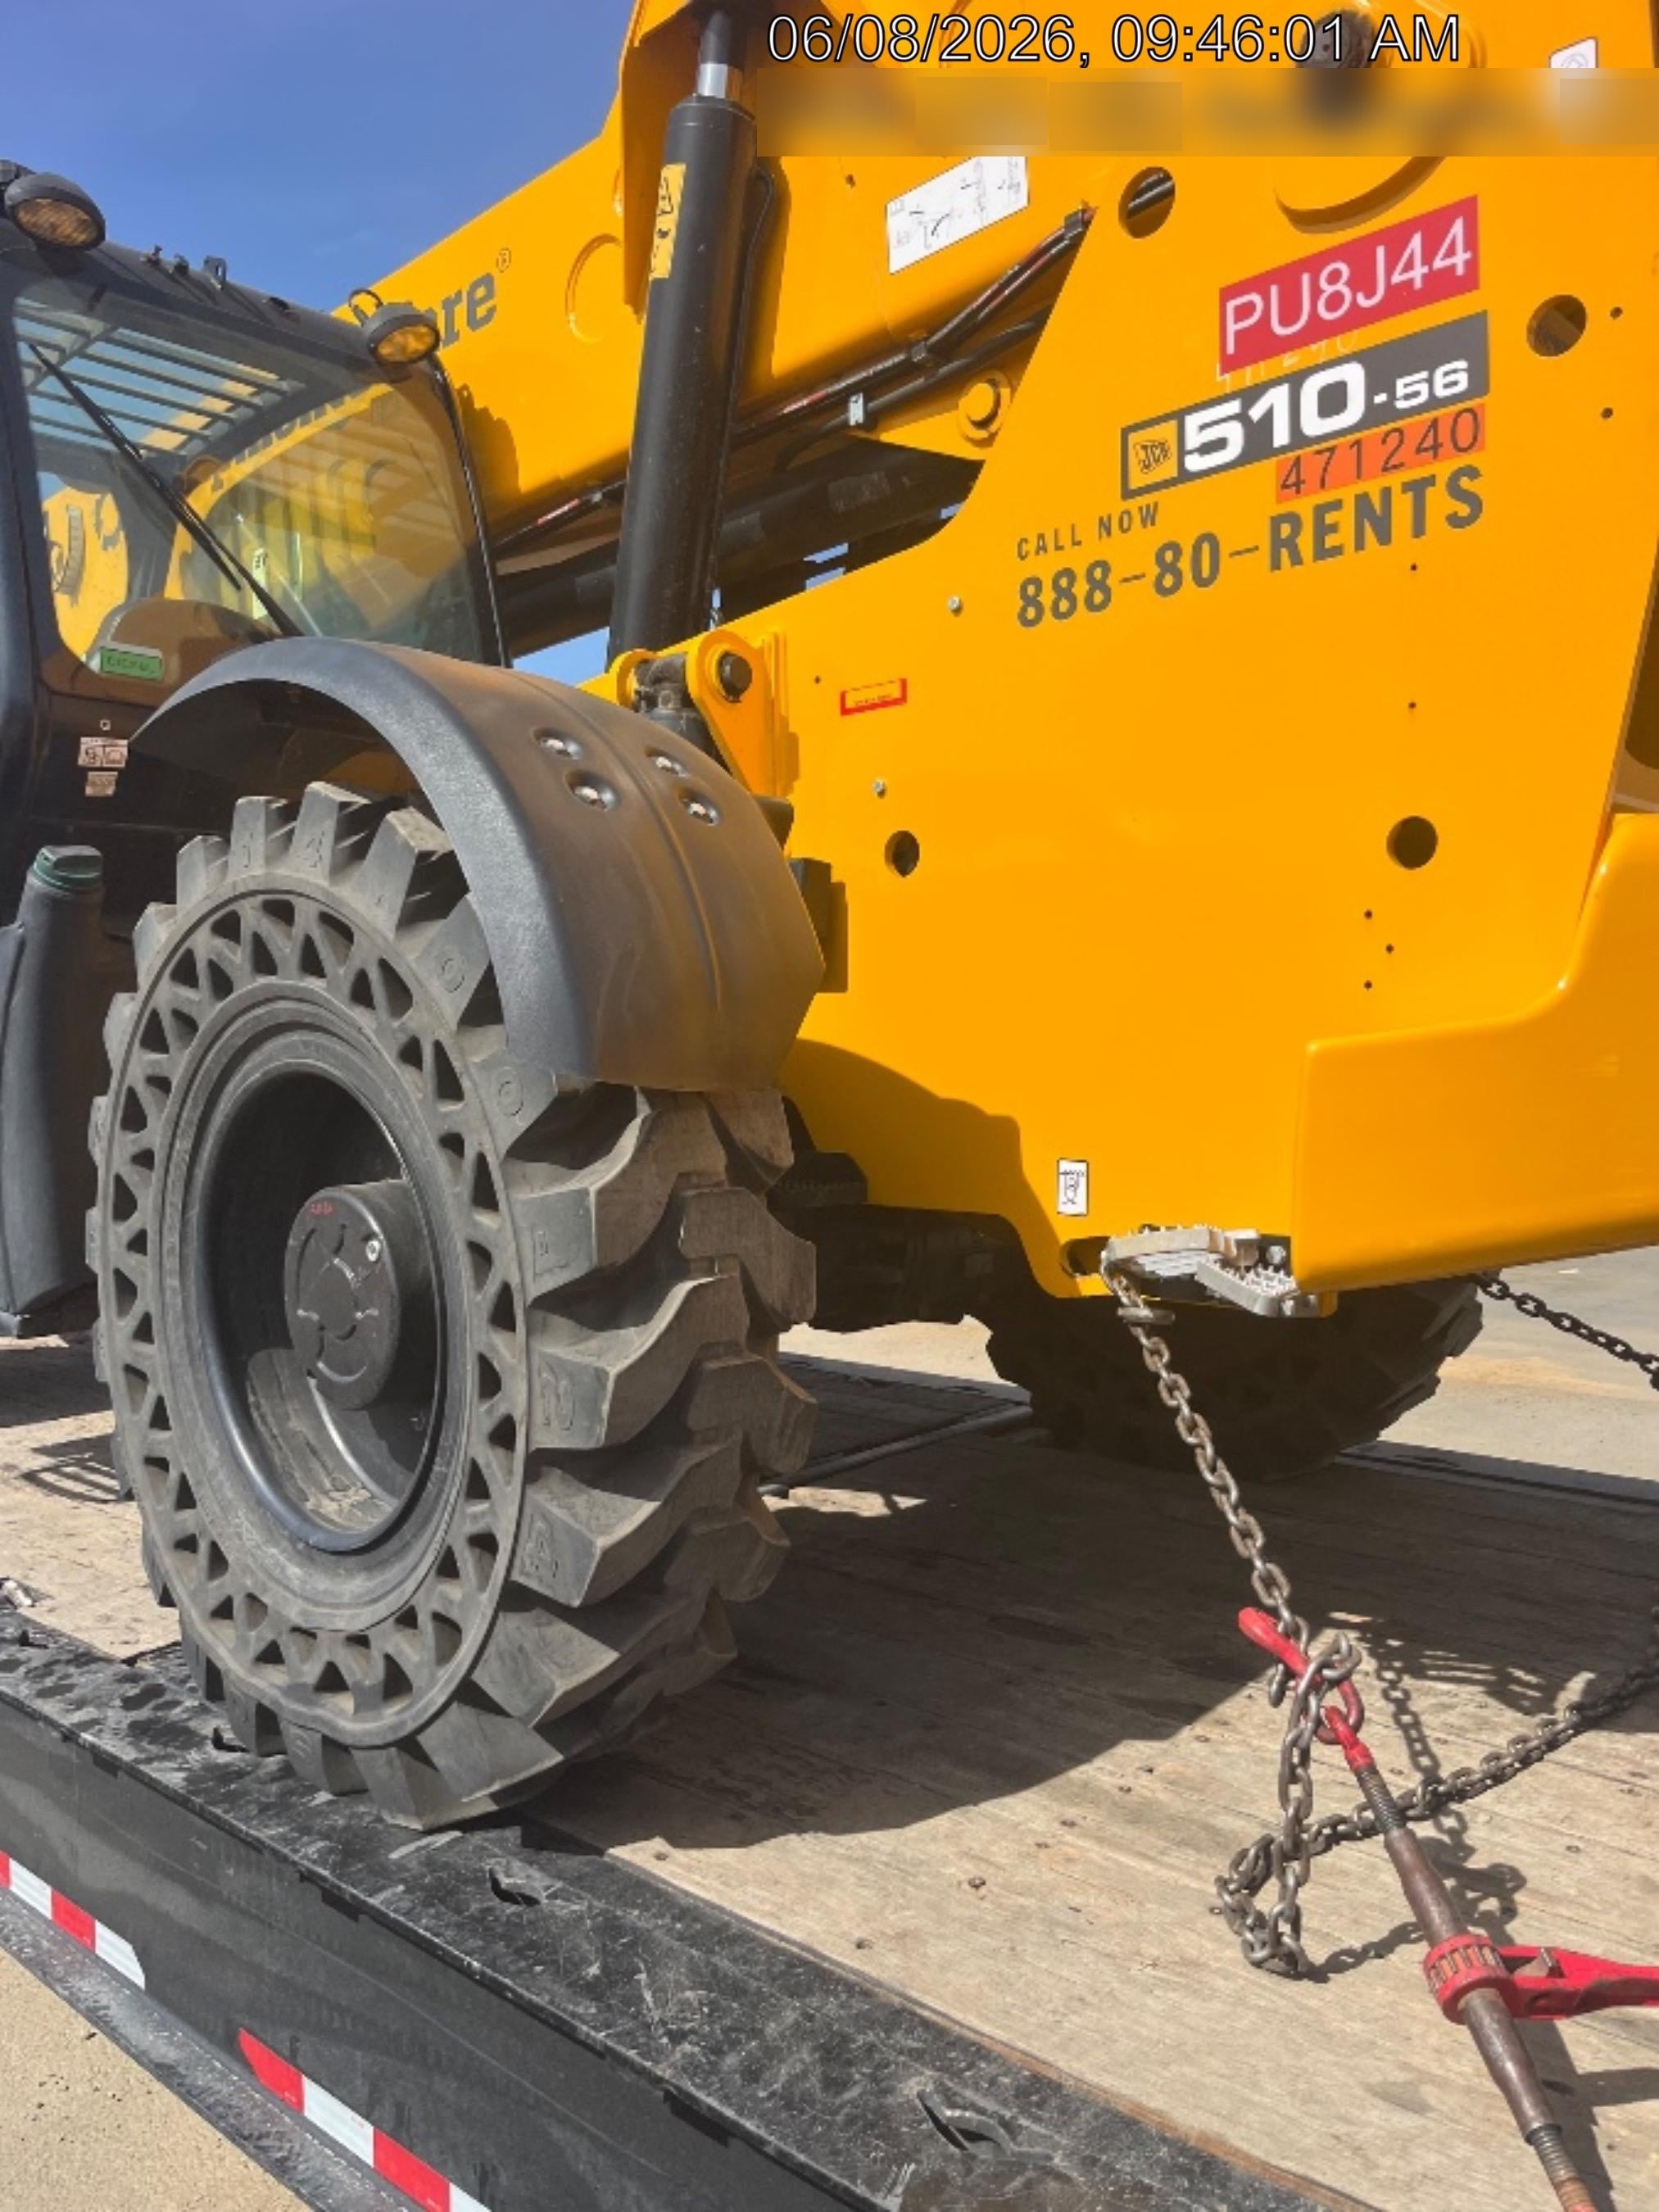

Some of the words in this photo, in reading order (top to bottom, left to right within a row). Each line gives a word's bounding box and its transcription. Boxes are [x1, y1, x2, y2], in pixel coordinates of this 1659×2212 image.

[1225, 215, 1473, 356] PU8J44
[1279, 406, 1481, 496] 471240
[1017, 523, 1083, 561] CALL
[1098, 501, 1158, 542] NOW
